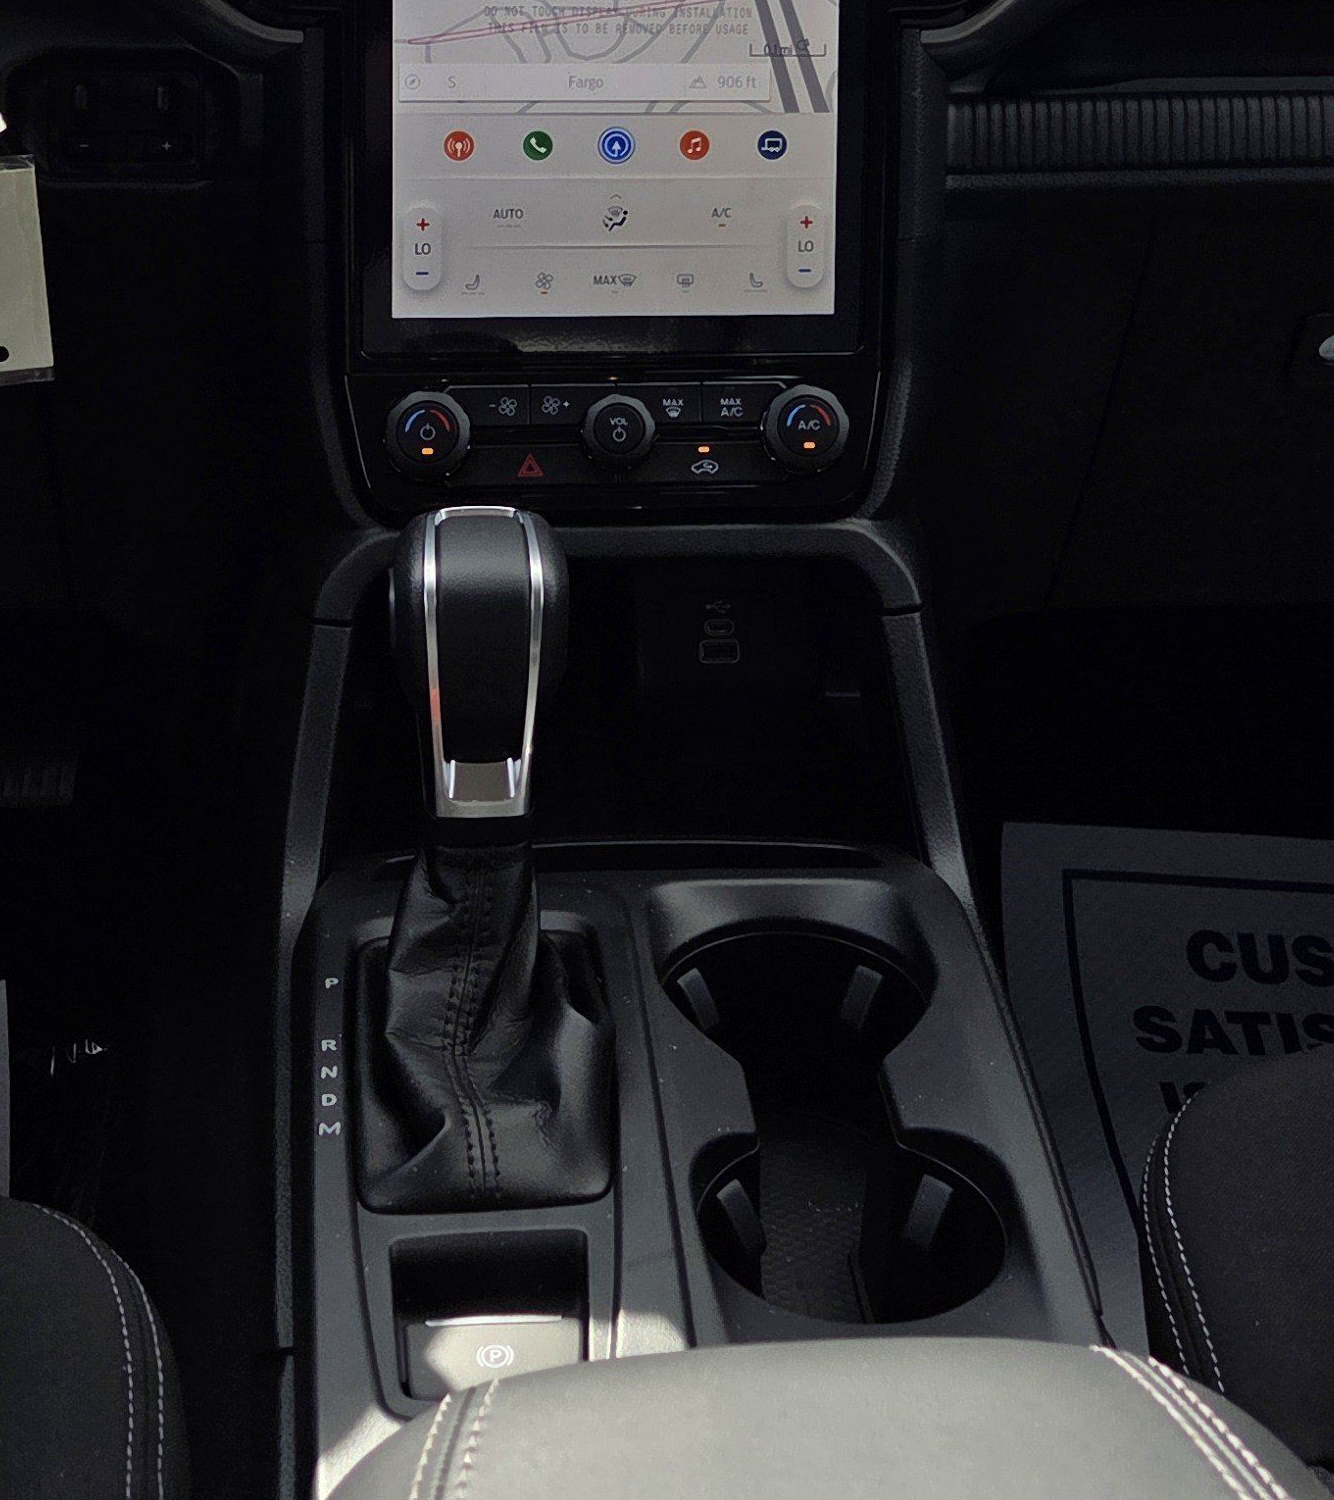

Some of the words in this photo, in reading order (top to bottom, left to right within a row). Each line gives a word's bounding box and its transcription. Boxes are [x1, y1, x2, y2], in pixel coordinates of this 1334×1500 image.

[715, 24, 749, 35] USAGE
[447, 76, 457, 89] S
[568, 75, 605, 90] Fargo
[717, 75, 743, 89] 906
[744, 75, 757, 89] ft
[492, 208, 524, 220] AUTO
[711, 206, 732, 220] A/C
[414, 243, 431, 256] LO
[797, 240, 814, 253] LO
[593, 275, 617, 286] MAX
[662, 398, 684, 406] MAX
[720, 397, 742, 406] MAX
[720, 406, 744, 417] A/C
[609, 417, 628, 426] VOL
[797, 419, 821, 431] A/C
[324, 977, 339, 990] P
[320, 1038, 337, 1052] R
[320, 1065, 338, 1080] N
[321, 1093, 337, 1107] D
[318, 1121, 342, 1136] M
